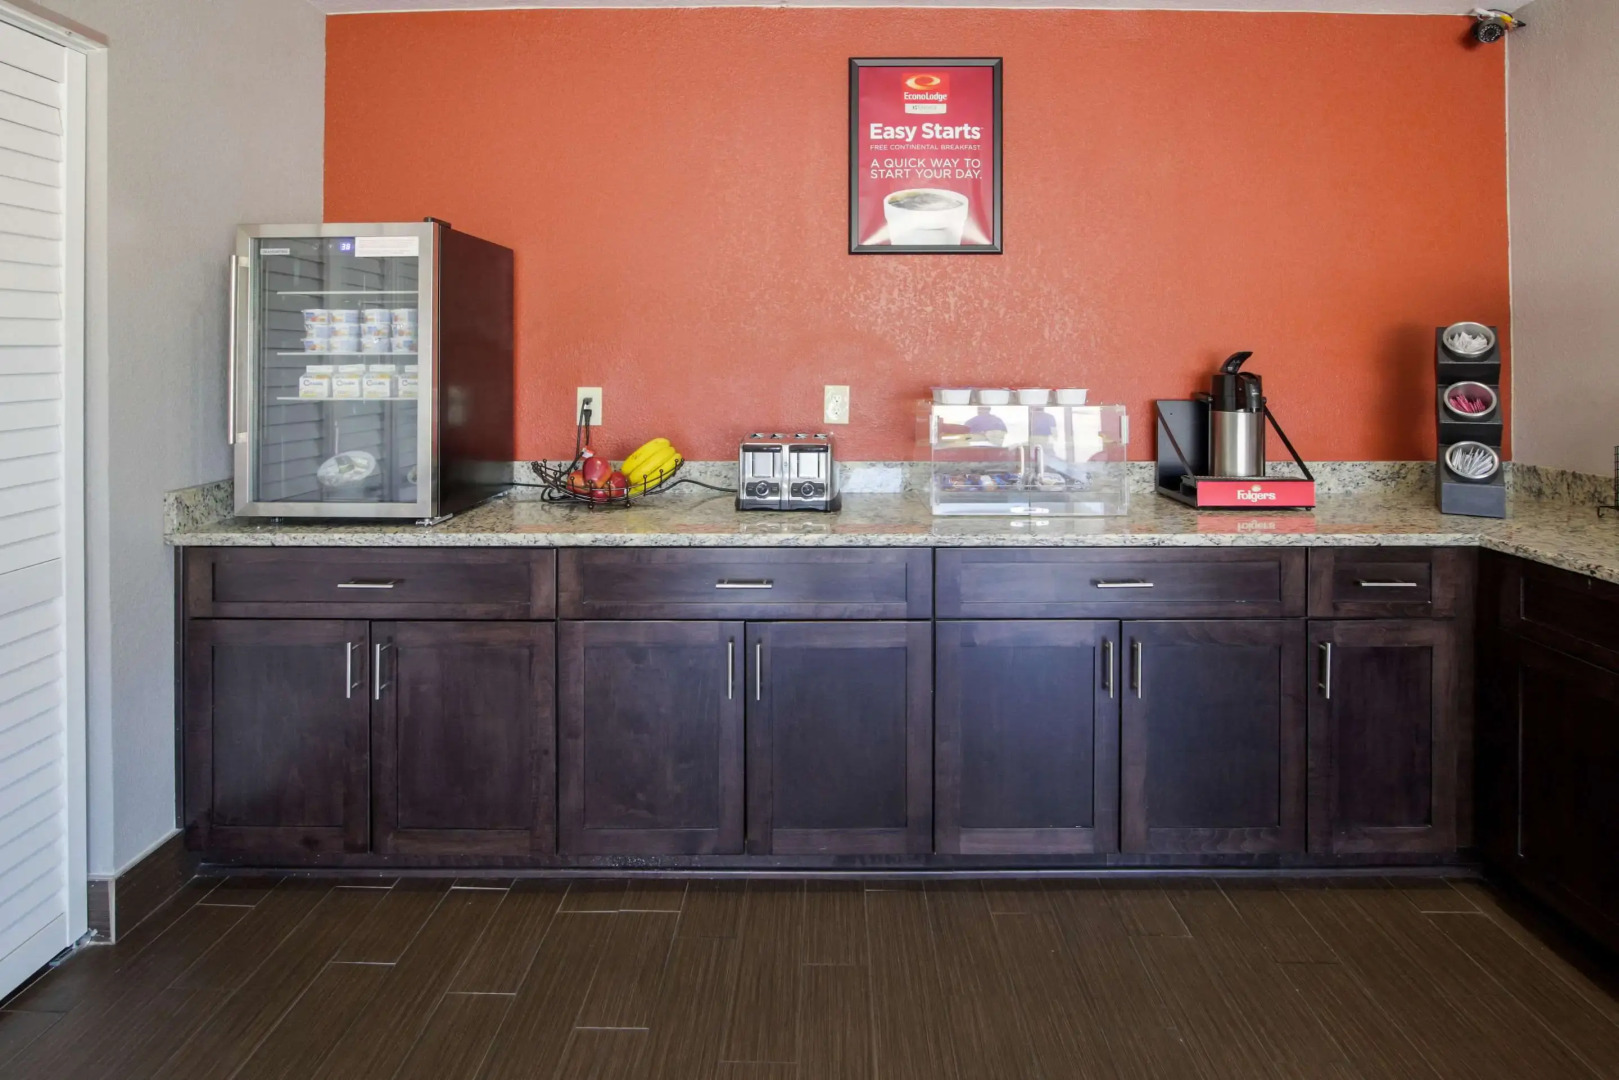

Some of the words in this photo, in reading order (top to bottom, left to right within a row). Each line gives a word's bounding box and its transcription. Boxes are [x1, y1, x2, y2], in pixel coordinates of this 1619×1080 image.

[870, 123, 917, 142] Easy
[922, 123, 981, 139] Starts
[870, 158, 880, 168] A
[884, 158, 926, 169] QUICK
[930, 158, 960, 168] WAY
[964, 158, 981, 169] TO
[870, 169, 911, 179] START
[916, 169, 952, 179] YOUR
[955, 169, 983, 180] DAY.
[1237, 489, 1276, 503] Folgers
